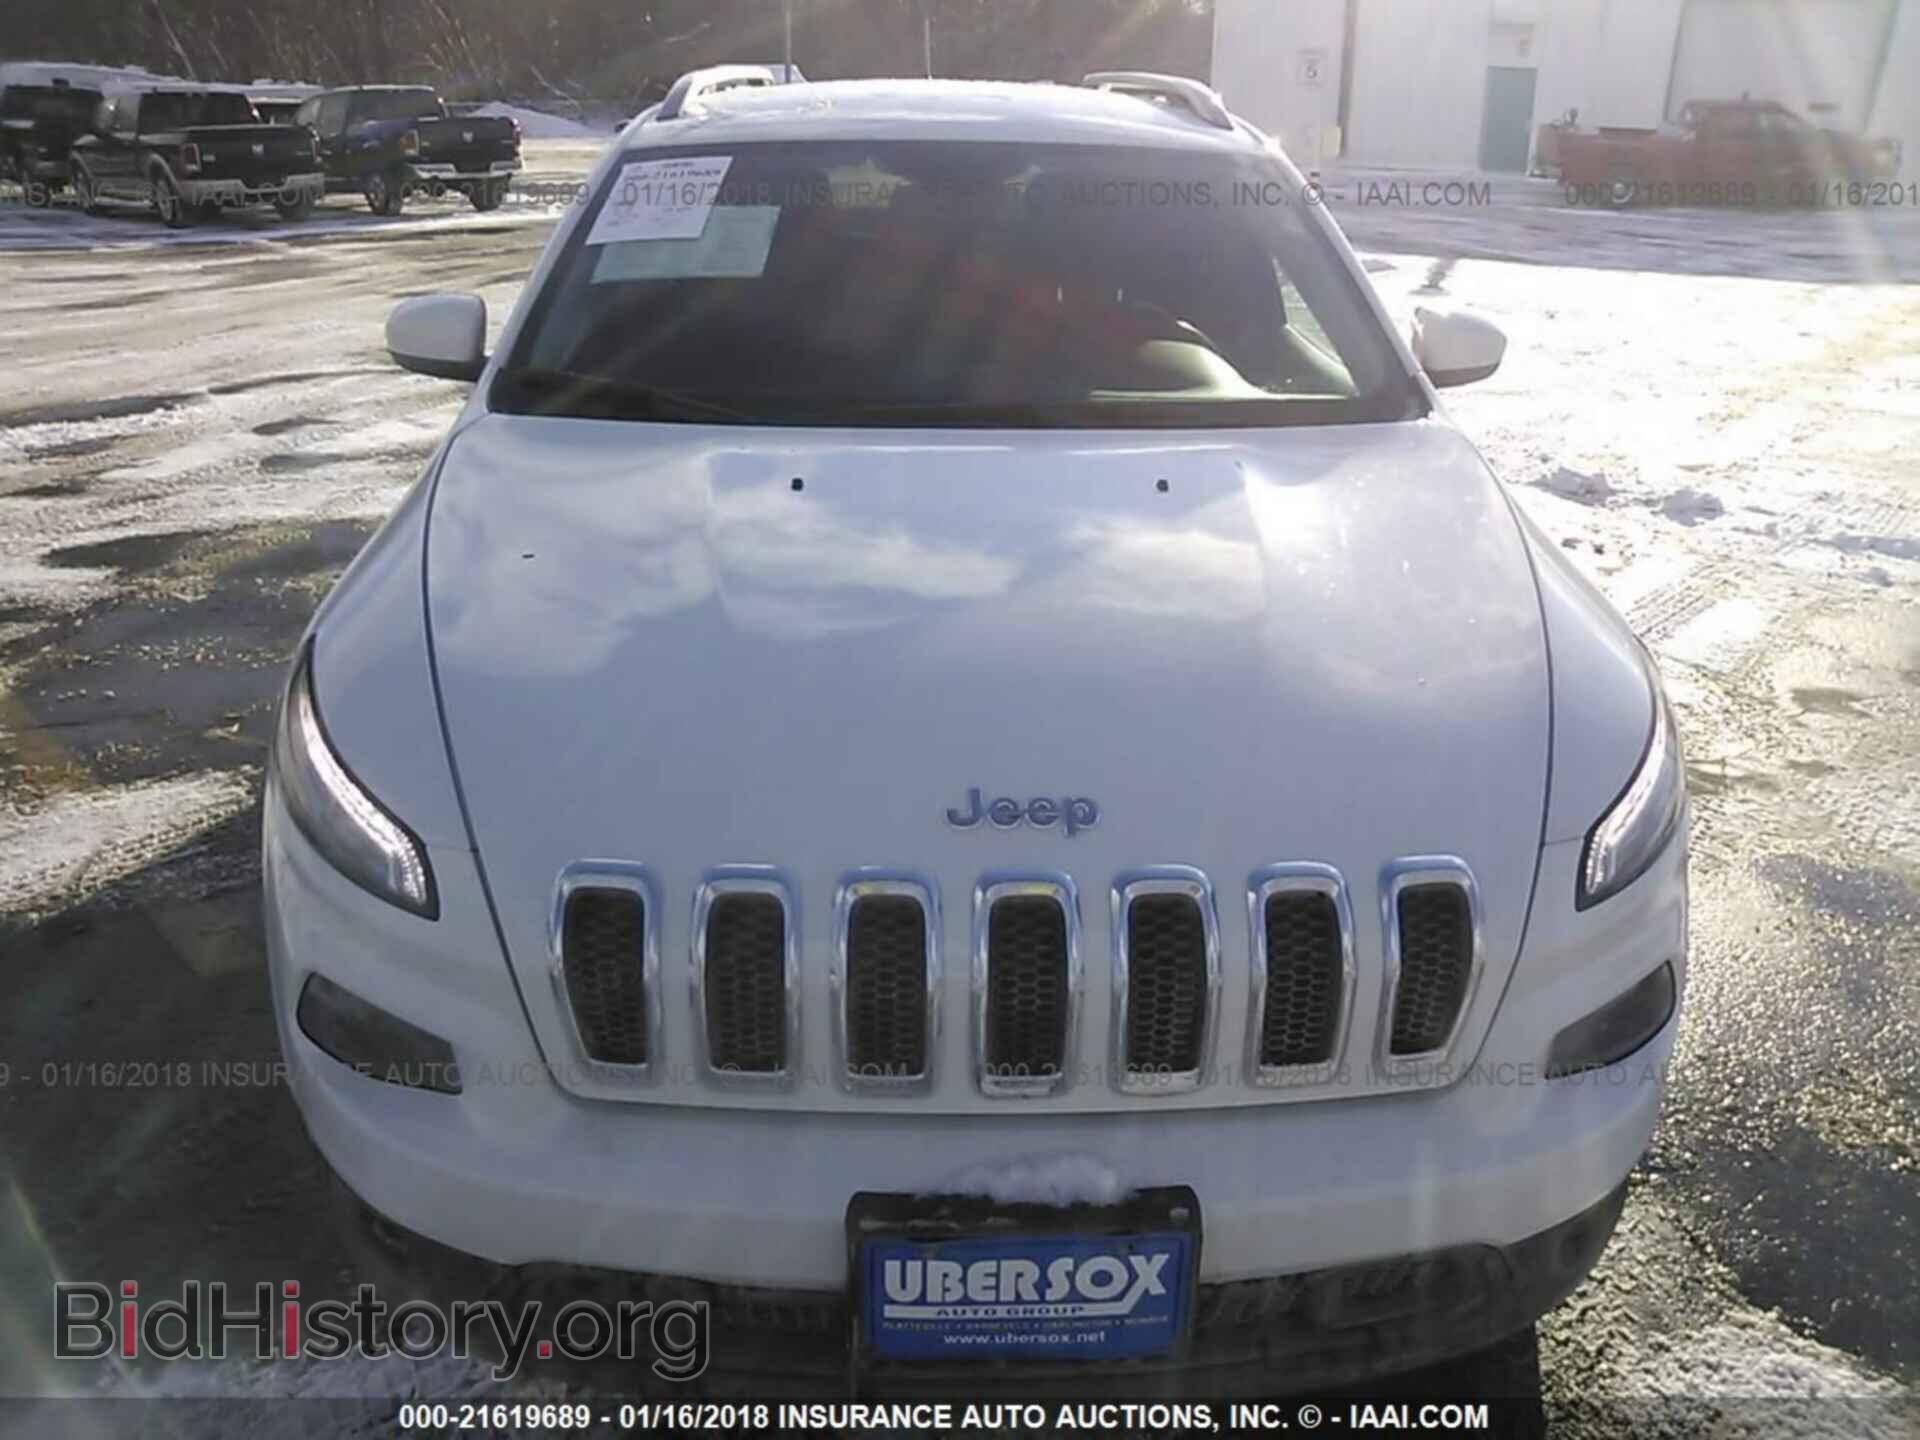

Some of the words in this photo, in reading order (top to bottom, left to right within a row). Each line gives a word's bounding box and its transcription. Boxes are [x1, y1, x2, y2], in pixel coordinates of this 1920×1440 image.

[946, 787, 1099, 839] Jeep
[884, 1253, 1170, 1303] UBERSOX
[936, 1306, 999, 1317] AUTO
[1006, 1304, 1083, 1317] GROUP
[943, 1330, 1106, 1345] www.ubersox.net
